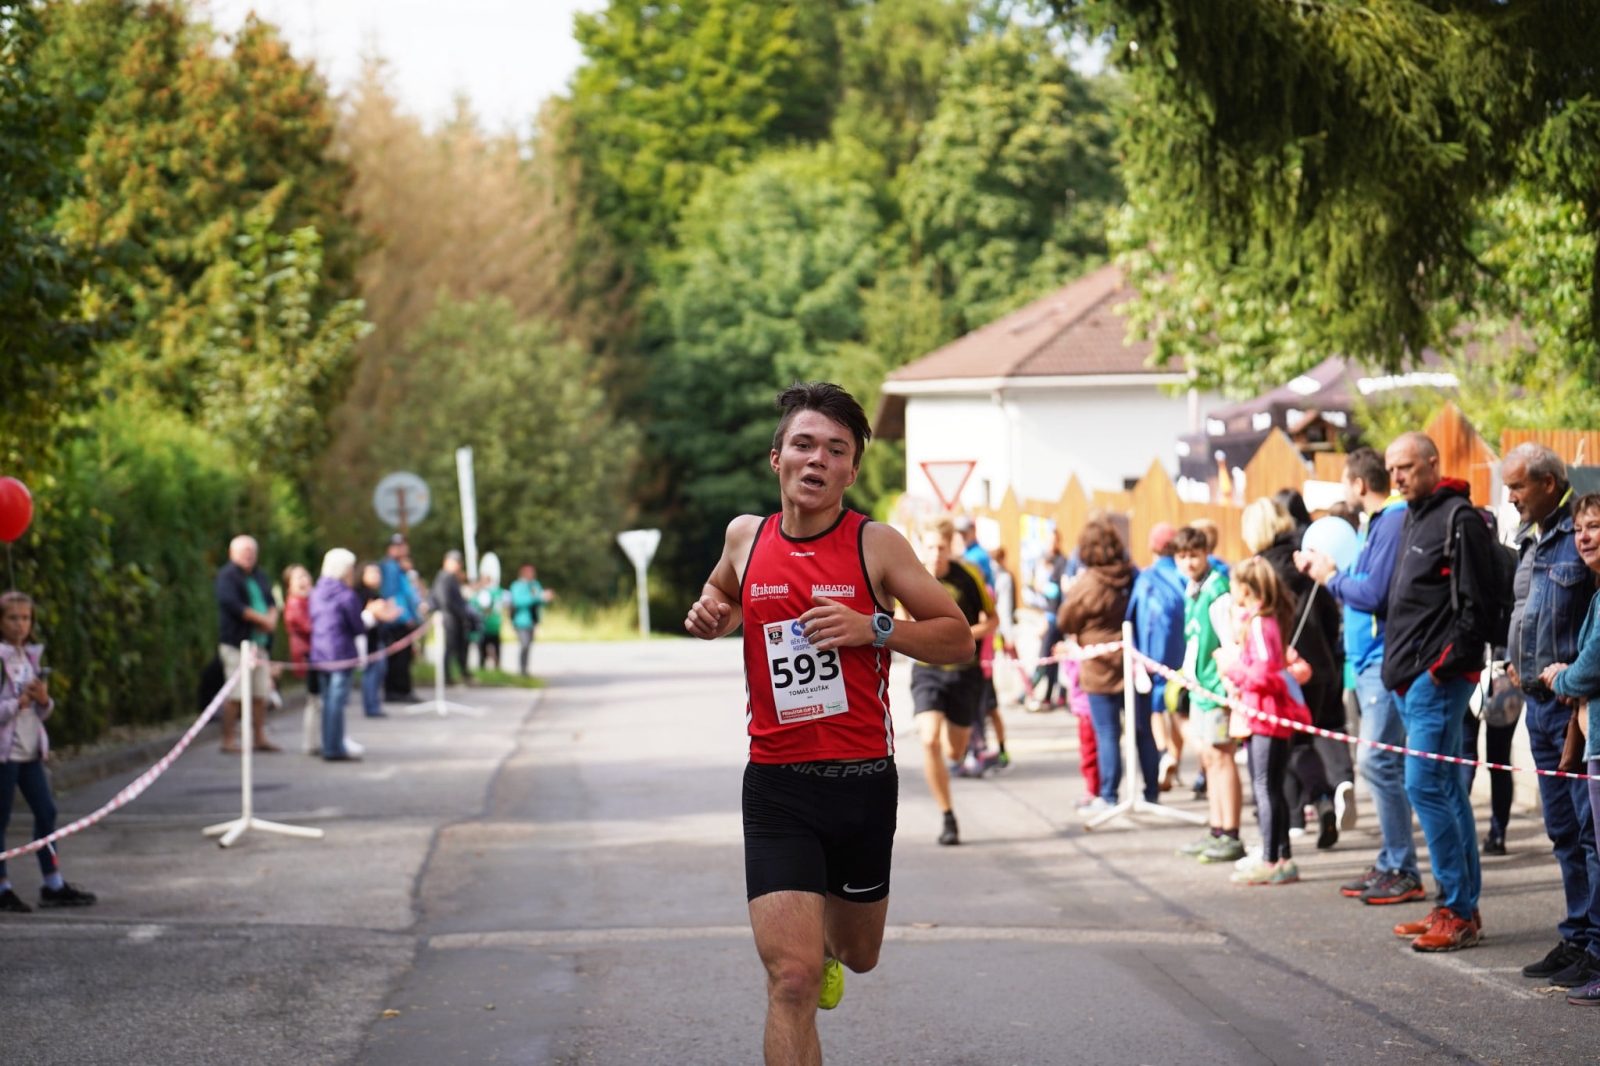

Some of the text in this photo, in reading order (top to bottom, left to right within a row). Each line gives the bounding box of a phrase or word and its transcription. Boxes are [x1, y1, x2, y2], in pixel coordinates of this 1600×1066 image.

[812, 584, 855, 592] MARATON
[772, 650, 839, 688] 593
[788, 687, 809, 696] TOMÁŠ
[842, 759, 888, 777] PRO
